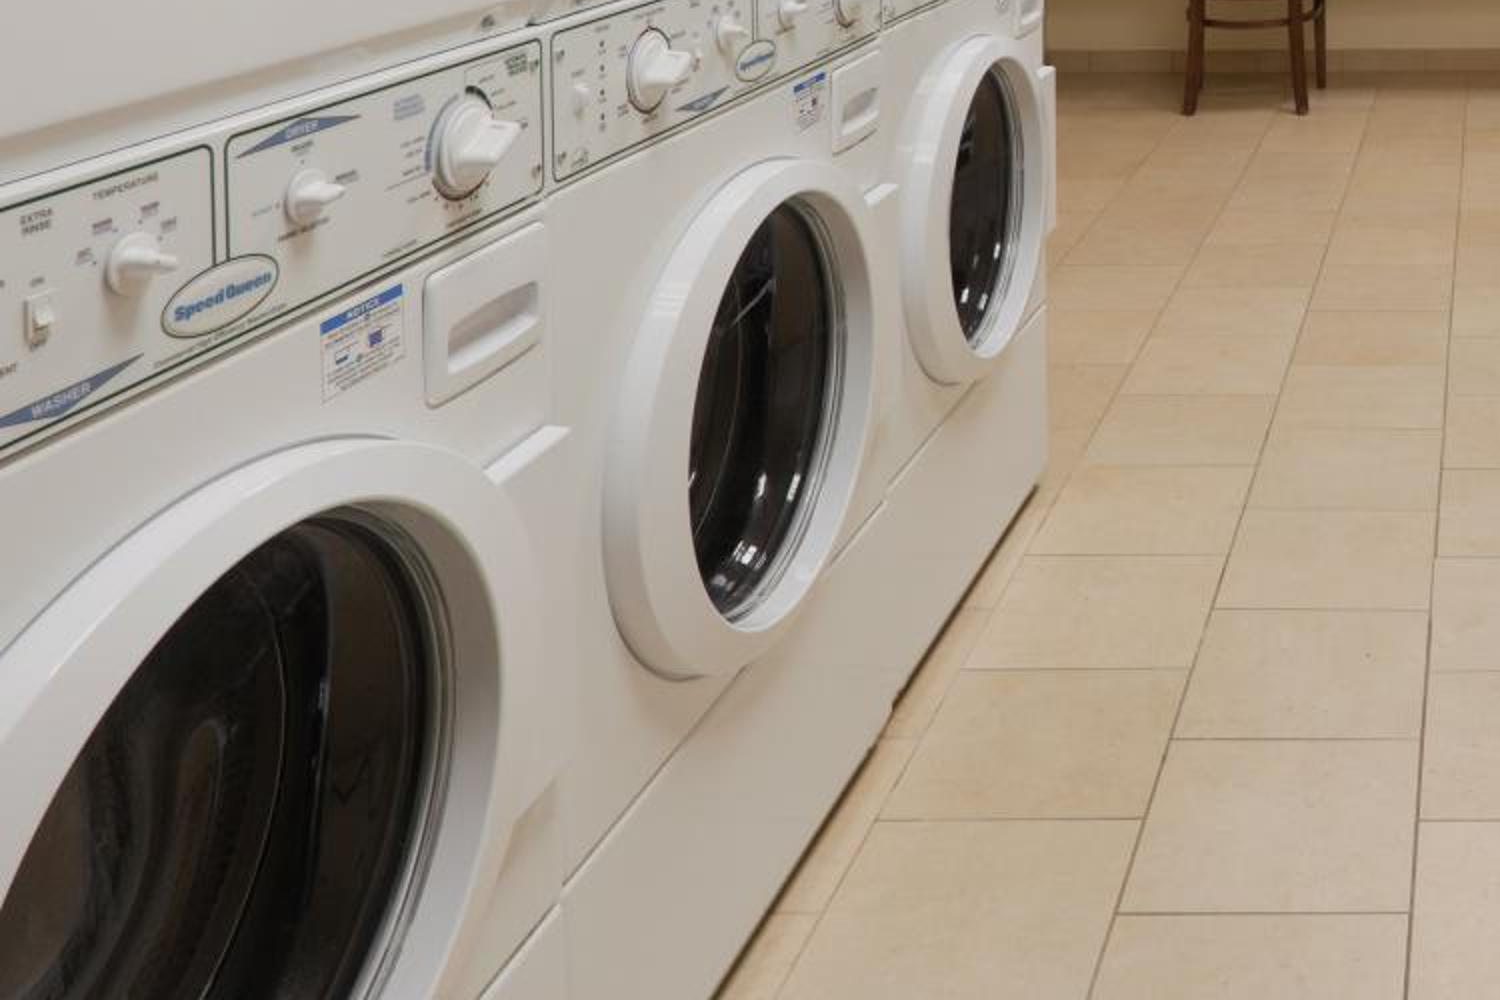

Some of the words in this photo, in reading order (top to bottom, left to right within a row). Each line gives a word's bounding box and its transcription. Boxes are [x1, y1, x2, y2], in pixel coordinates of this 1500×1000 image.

[92, 171, 159, 200] TEMPERATURE
[20, 208, 52, 225] EXTRA
[21, 219, 52, 236] RINSE
[174, 288, 225, 322] Speed
[225, 271, 271, 299] Queen
[31, 382, 92, 419] WASHER
